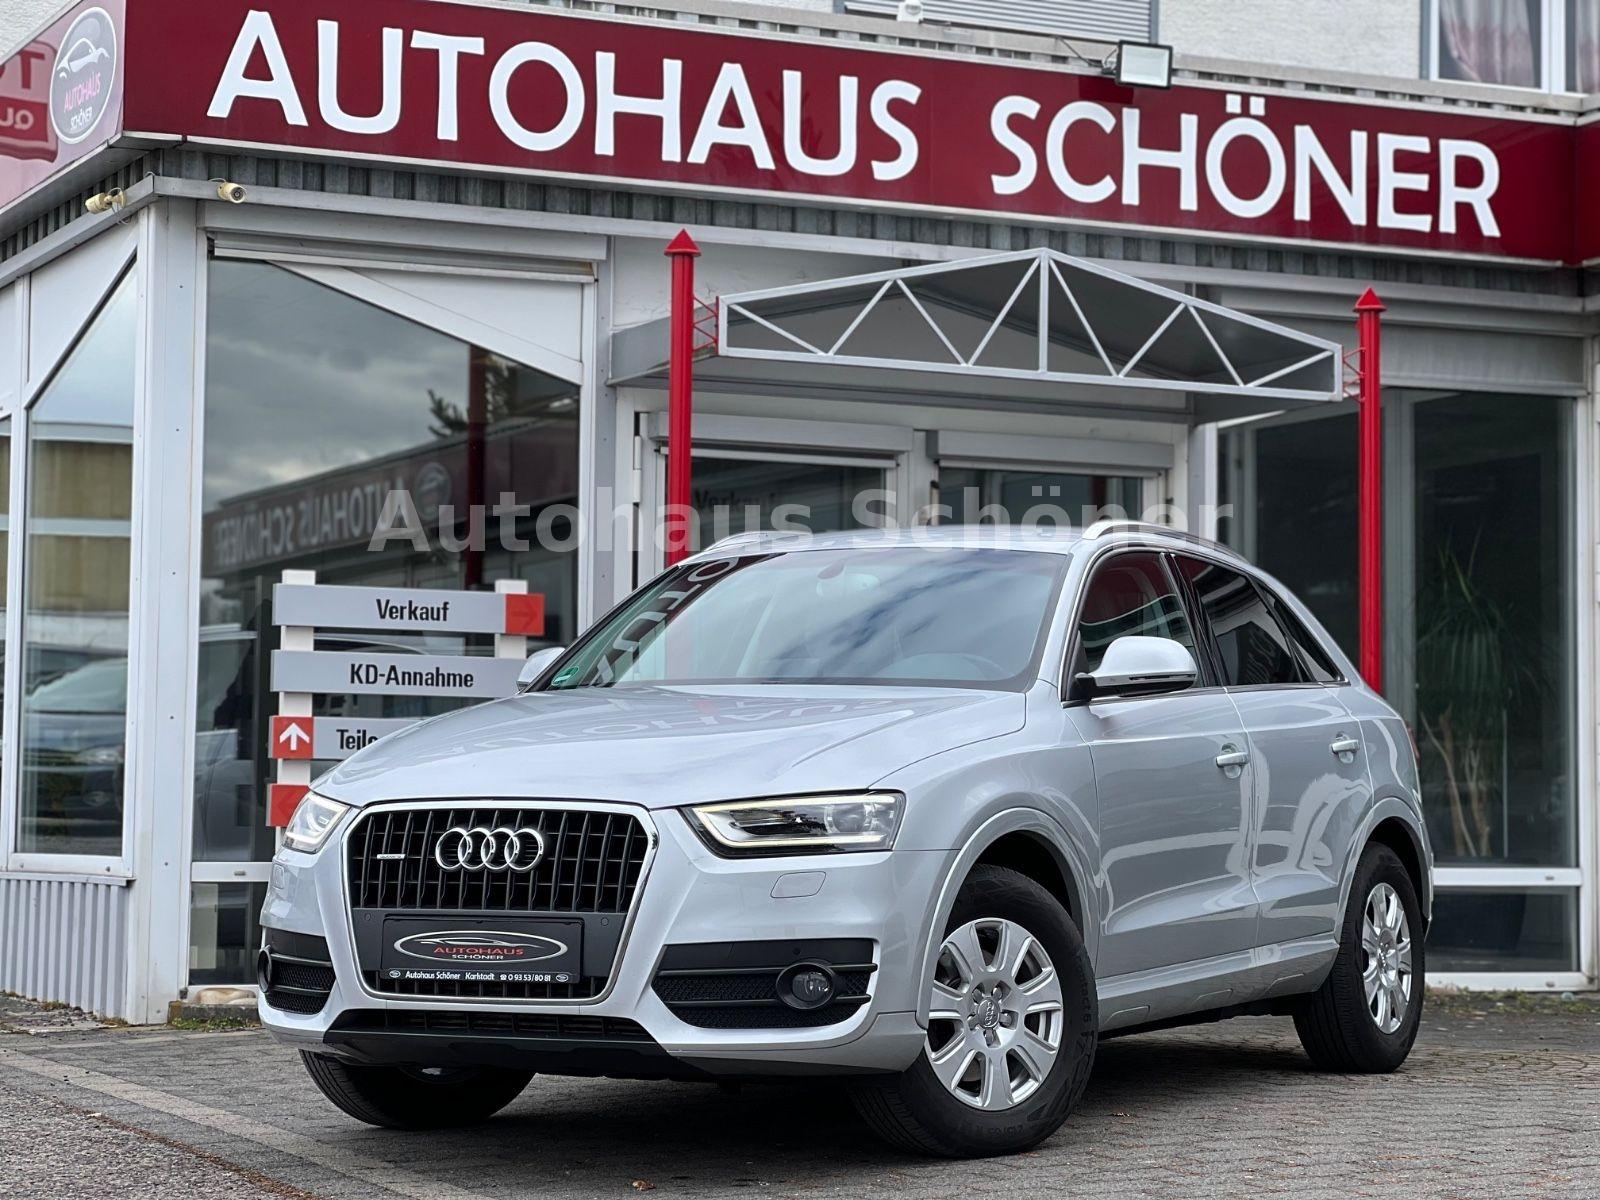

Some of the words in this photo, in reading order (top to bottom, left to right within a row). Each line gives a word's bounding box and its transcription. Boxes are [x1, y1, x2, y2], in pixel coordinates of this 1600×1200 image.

[63, 71, 101, 113] AUTOHAUS
[206, 9, 922, 183] AUTOHAUS
[989, 93, 1502, 239] SCHÖNER
[376, 598, 450, 622] Verkauf
[349, 663, 474, 688] KD-Annahme
[434, 947, 524, 956] AUTOHAUS
[405, 971, 434, 980] Autohaus
[436, 971, 460, 980] Schöner
[465, 972, 495, 981] Karlstadt
